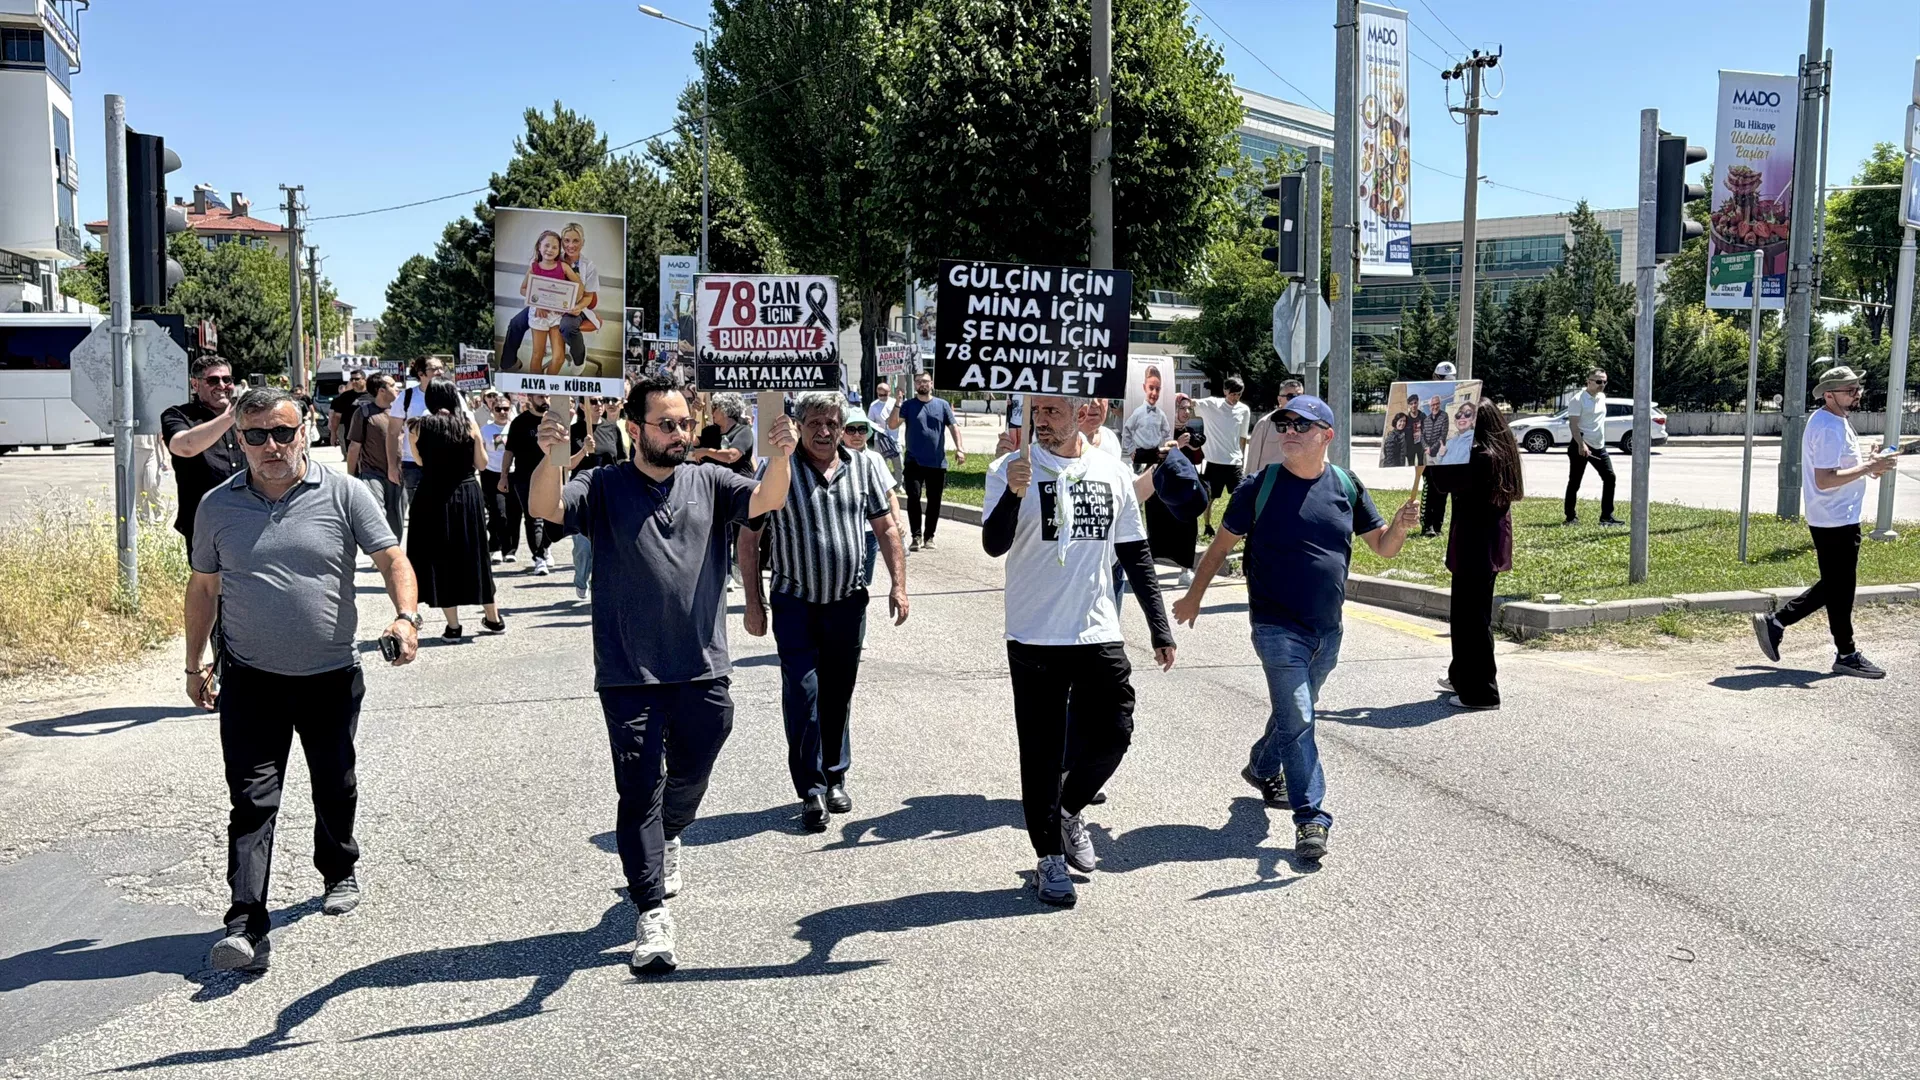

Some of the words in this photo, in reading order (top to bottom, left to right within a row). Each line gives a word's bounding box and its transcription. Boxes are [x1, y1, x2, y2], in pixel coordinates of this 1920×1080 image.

[1368, 25, 1398, 46] MADO
[1733, 88, 1780, 107] MADO
[1734, 119, 1746, 128] Bu
[1748, 120, 1776, 132] Hikaye
[1730, 131, 1776, 146] Ustalıkla
[948, 262, 1050, 294] GÜLÇİN
[1060, 268, 1114, 298] İÇİN
[705, 281, 756, 326] 78
[759, 282, 800, 304] CAN
[968, 292, 1040, 319] MİNA
[1051, 296, 1104, 326] İÇİN
[767, 306, 793, 323] İÇİN
[719, 328, 816, 350] BURADAYIZ
[962, 320, 1052, 344] ŞENOL
[1060, 324, 1110, 353] İÇİN
[880, 351, 904, 360] ADALET
[945, 343, 972, 360] 78
[979, 346, 1069, 367] CANIMIZ
[1077, 350, 1116, 372] İÇİN
[456, 364, 478, 374] HİÇBİR
[456, 371, 485, 380] MAKAM
[715, 366, 823, 381] KARTALKAYA
[521, 378, 546, 390] ALYA
[564, 379, 602, 393] KÜBRA
[728, 380, 751, 388] AİLE
[960, 364, 1102, 395] ADALET
[1087, 482, 1106, 494] İÇİN
[1085, 494, 1106, 505] İÇİN
[1090, 504, 1109, 517] İÇİN
